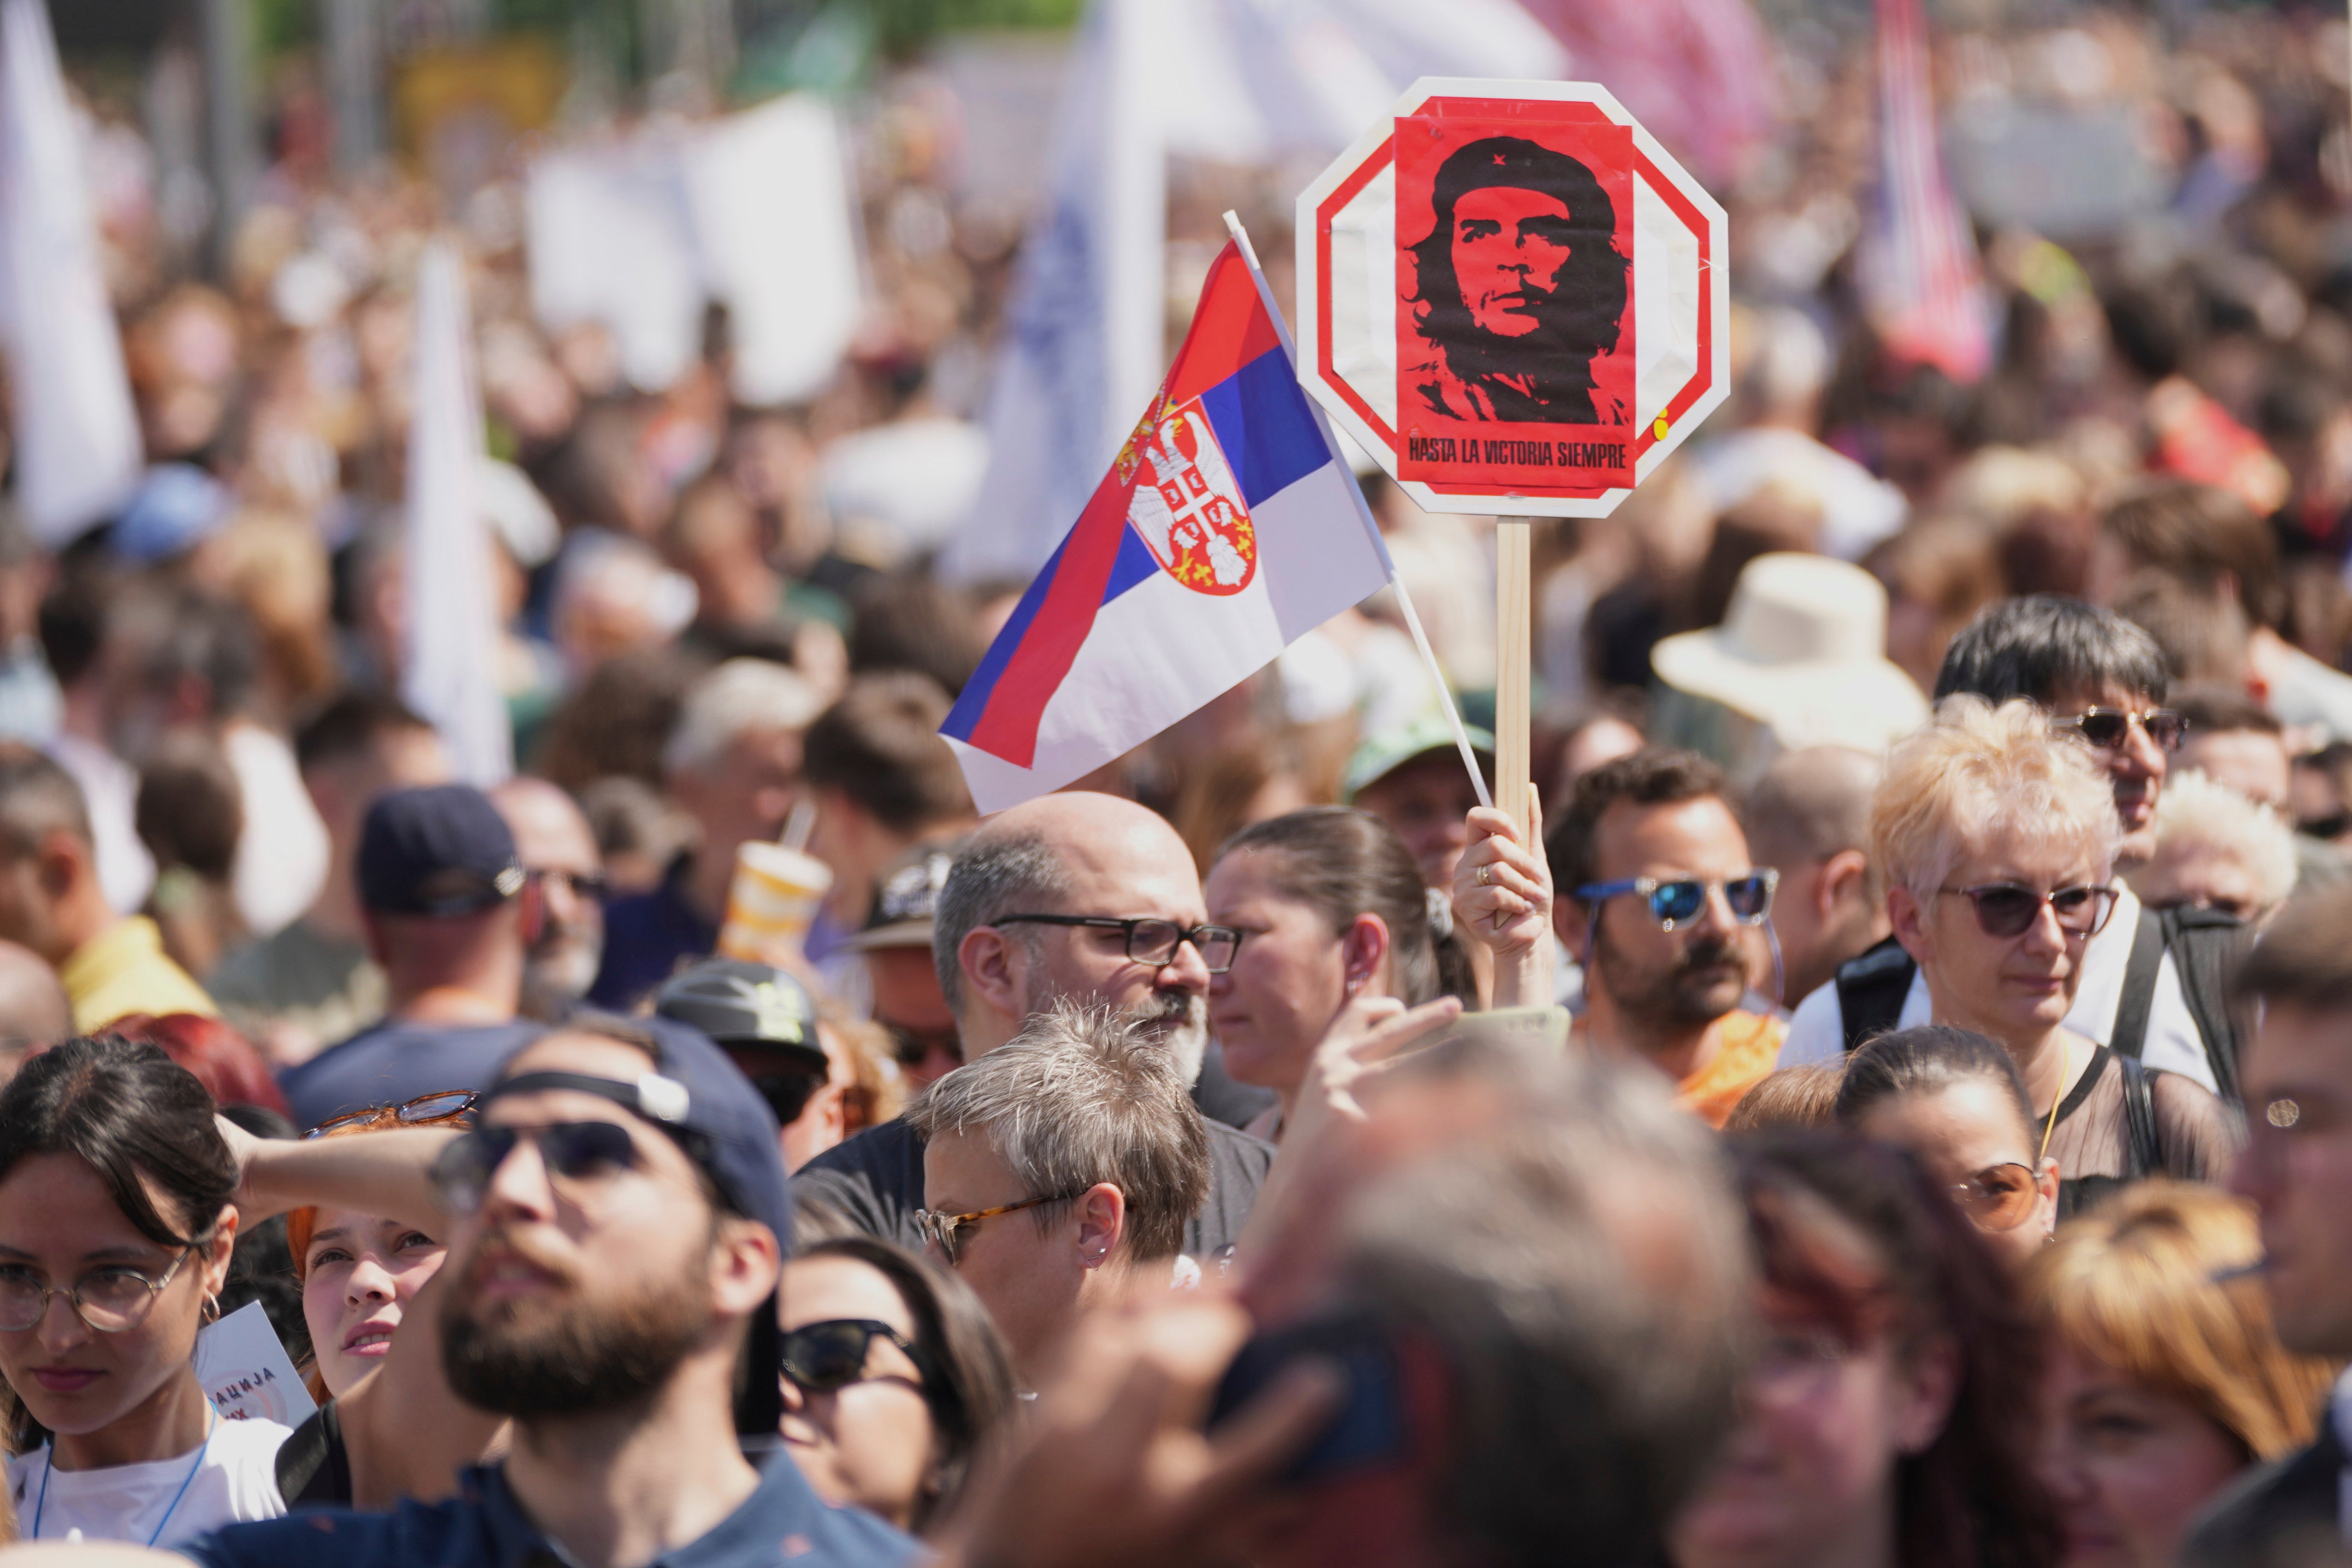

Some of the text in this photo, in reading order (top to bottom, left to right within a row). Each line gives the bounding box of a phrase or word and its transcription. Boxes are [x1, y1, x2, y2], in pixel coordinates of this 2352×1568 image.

[1409, 438, 1626, 468] HASTA LA VICTORIA SIEMPRE
